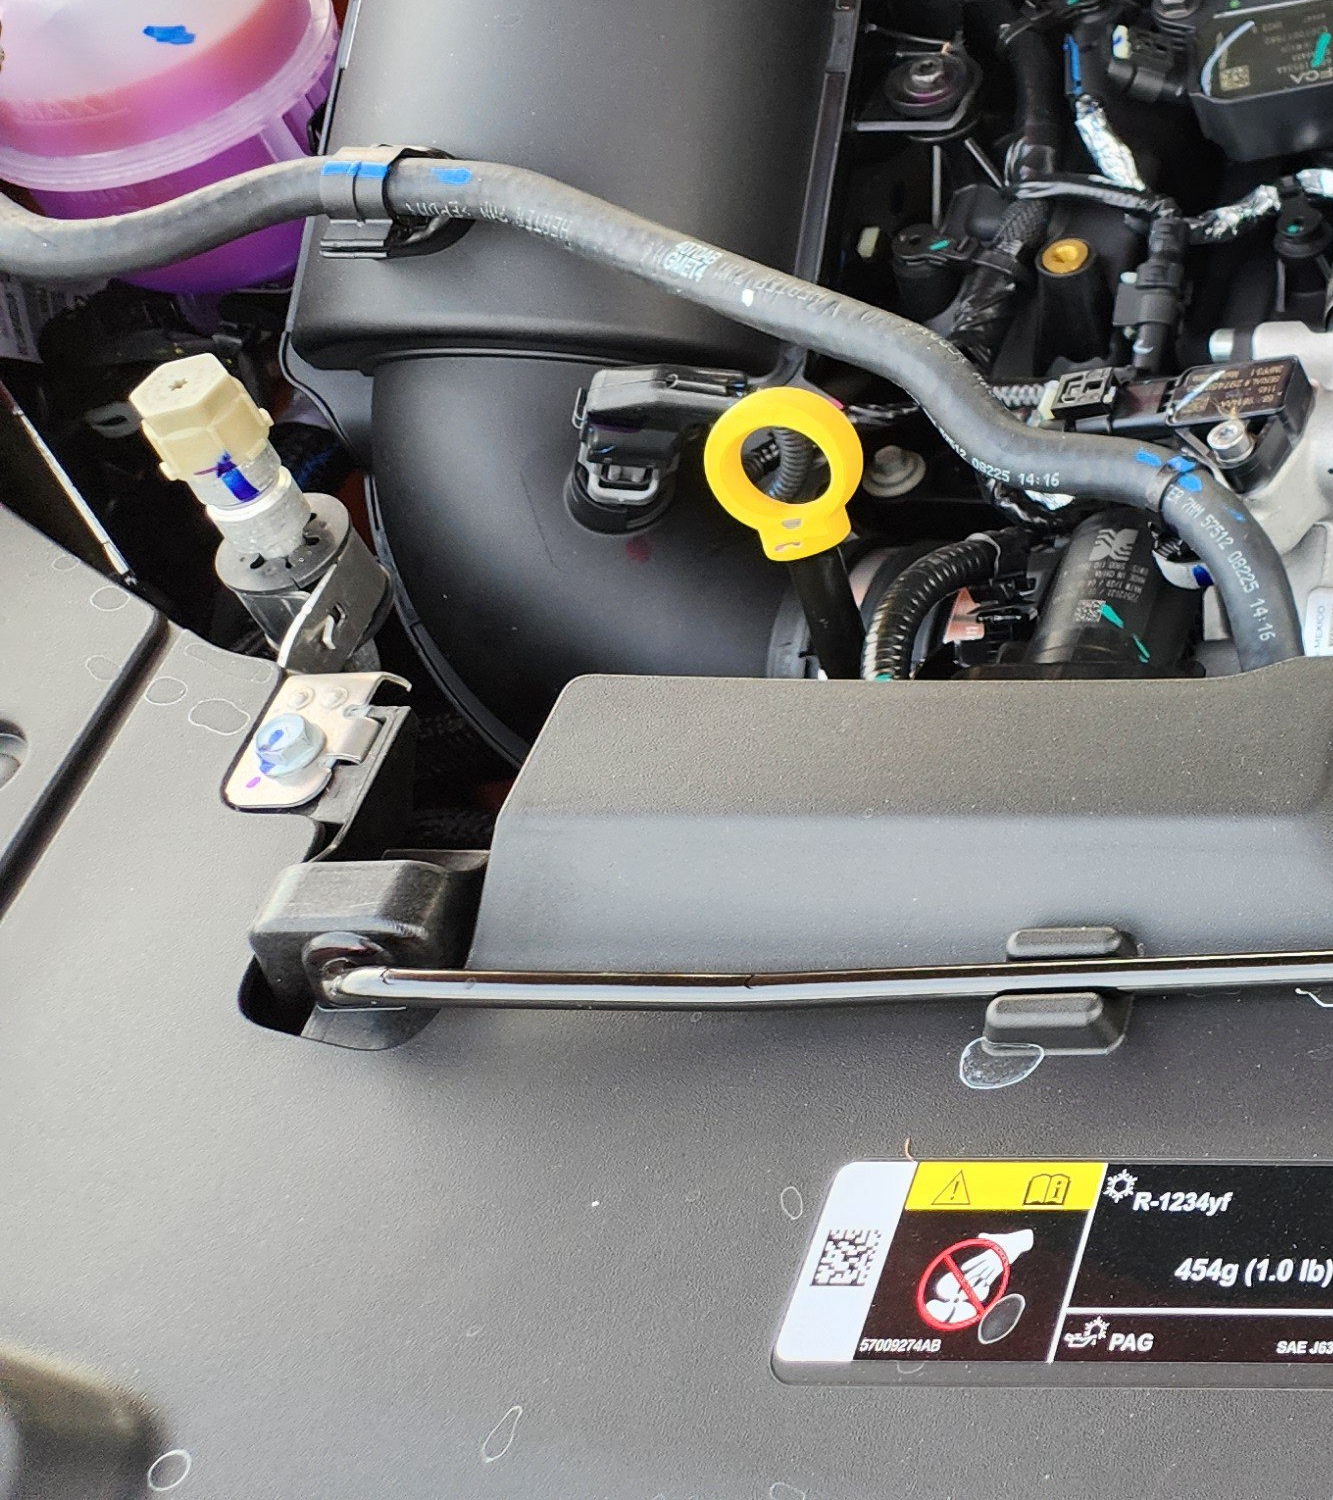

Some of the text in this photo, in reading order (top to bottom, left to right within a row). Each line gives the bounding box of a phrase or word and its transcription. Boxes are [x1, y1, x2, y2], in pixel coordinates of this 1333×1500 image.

[1020, 472, 1060, 487] 14:16
[1228, 553, 1260, 595] 08225
[1251, 597, 1276, 642] 14:16
[1132, 1190, 1233, 1215] R-1234yf
[1174, 1257, 1333, 1287] 454g (1.0 lb)
[859, 1336, 942, 1354] 57009274AB
[1109, 1332, 1155, 1353] PAG
[1276, 1339, 1308, 1357] SAE
